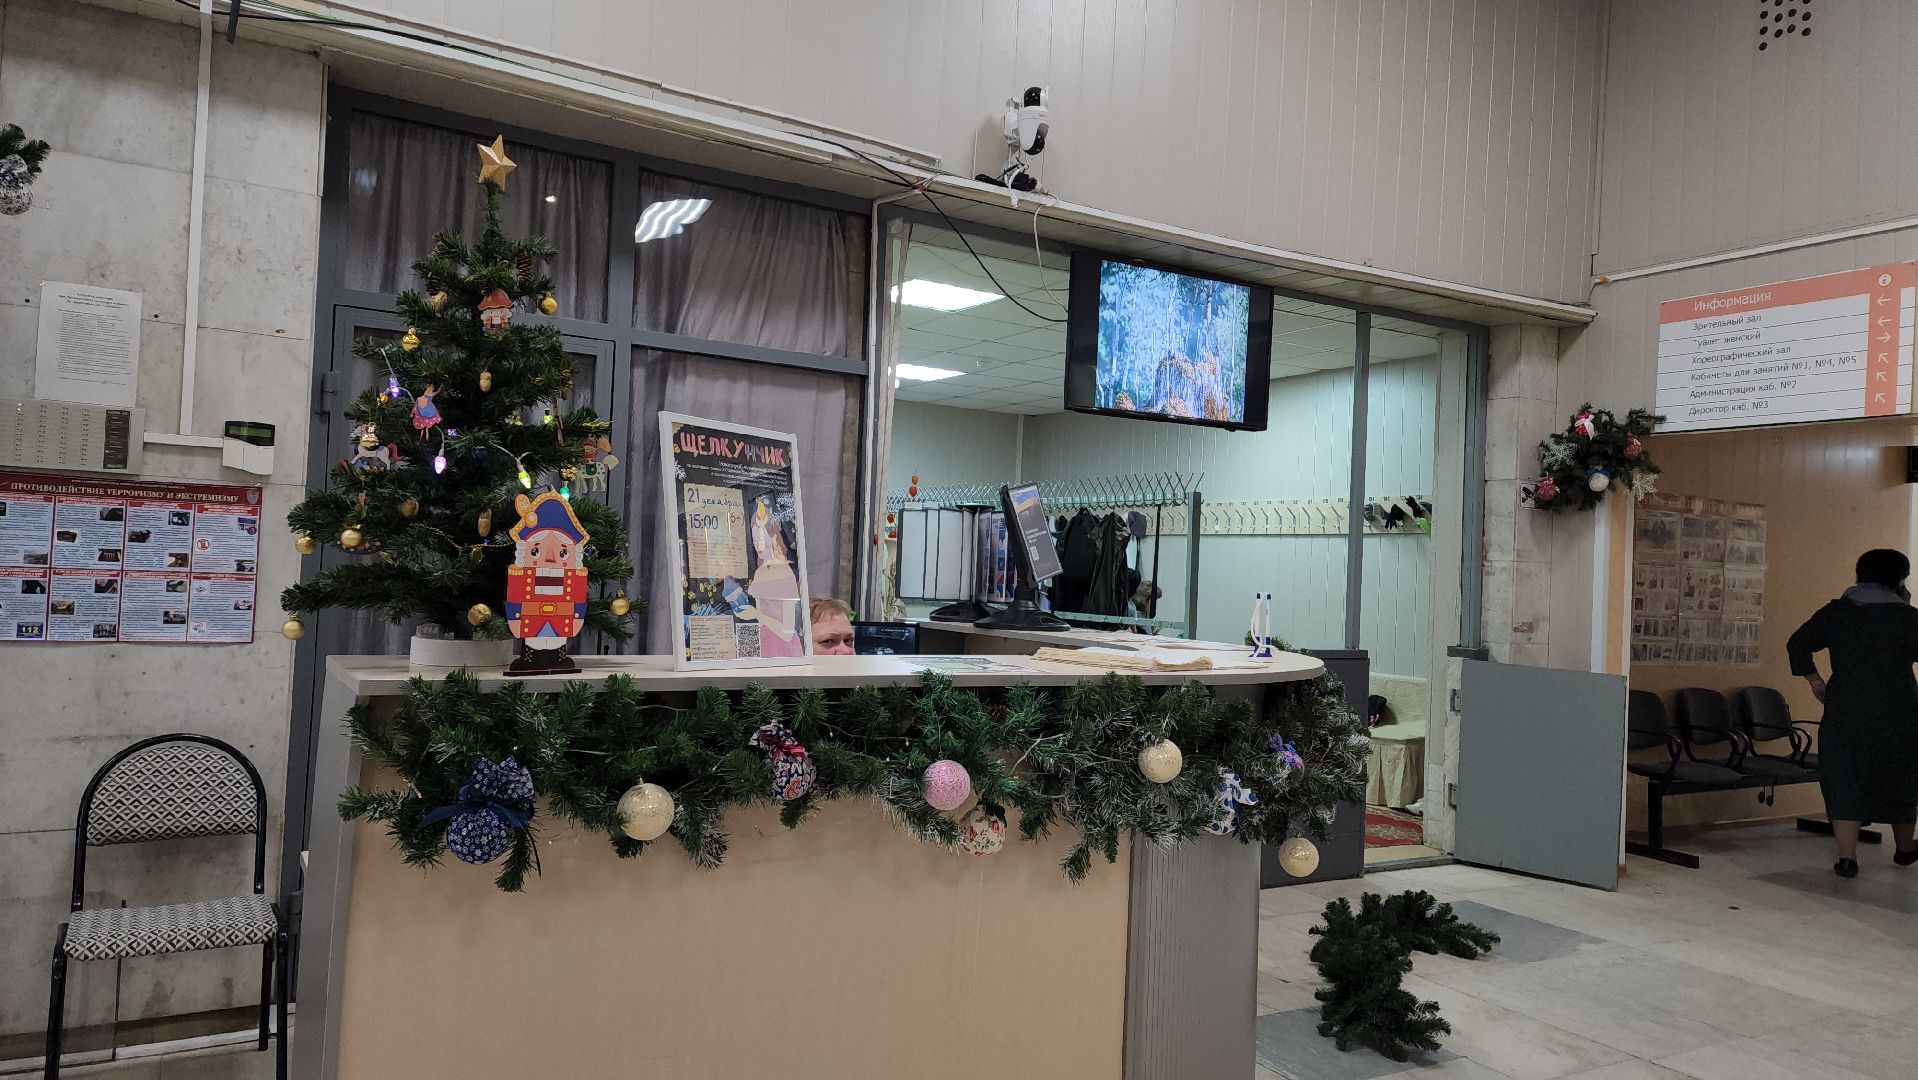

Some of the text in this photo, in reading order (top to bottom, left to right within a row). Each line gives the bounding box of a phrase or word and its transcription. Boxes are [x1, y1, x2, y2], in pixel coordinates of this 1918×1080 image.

[1694, 291, 1772, 311] Информация
[1693, 315, 1762, 331] Зрительный зал
[1723, 331, 1761, 344] женский
[1691, 346, 1791, 364] Хореографический зал
[1691, 371, 1732, 381] Кабинеты
[1734, 369, 1750, 378] для
[1753, 362, 1789, 375] занятий
[1689, 386, 1756, 399] Администрация
[1758, 382, 1777, 392] каб.
[1688, 404, 1730, 416] Директор
[1731, 402, 1749, 411] каб.
[680, 432, 786, 467] ЩЕЛКУНЧИК
[11, 482, 105, 495] ПРОТИВОДЕЙСТВИЕ
[106, 488, 165, 499] ТЕРРОРИЗМУ
[175, 492, 239, 503] ЭКСТРЕМИЗМУ
[687, 487, 700, 503] 21
[689, 513, 719, 530] 15:00
[21, 626, 39, 634] 112
